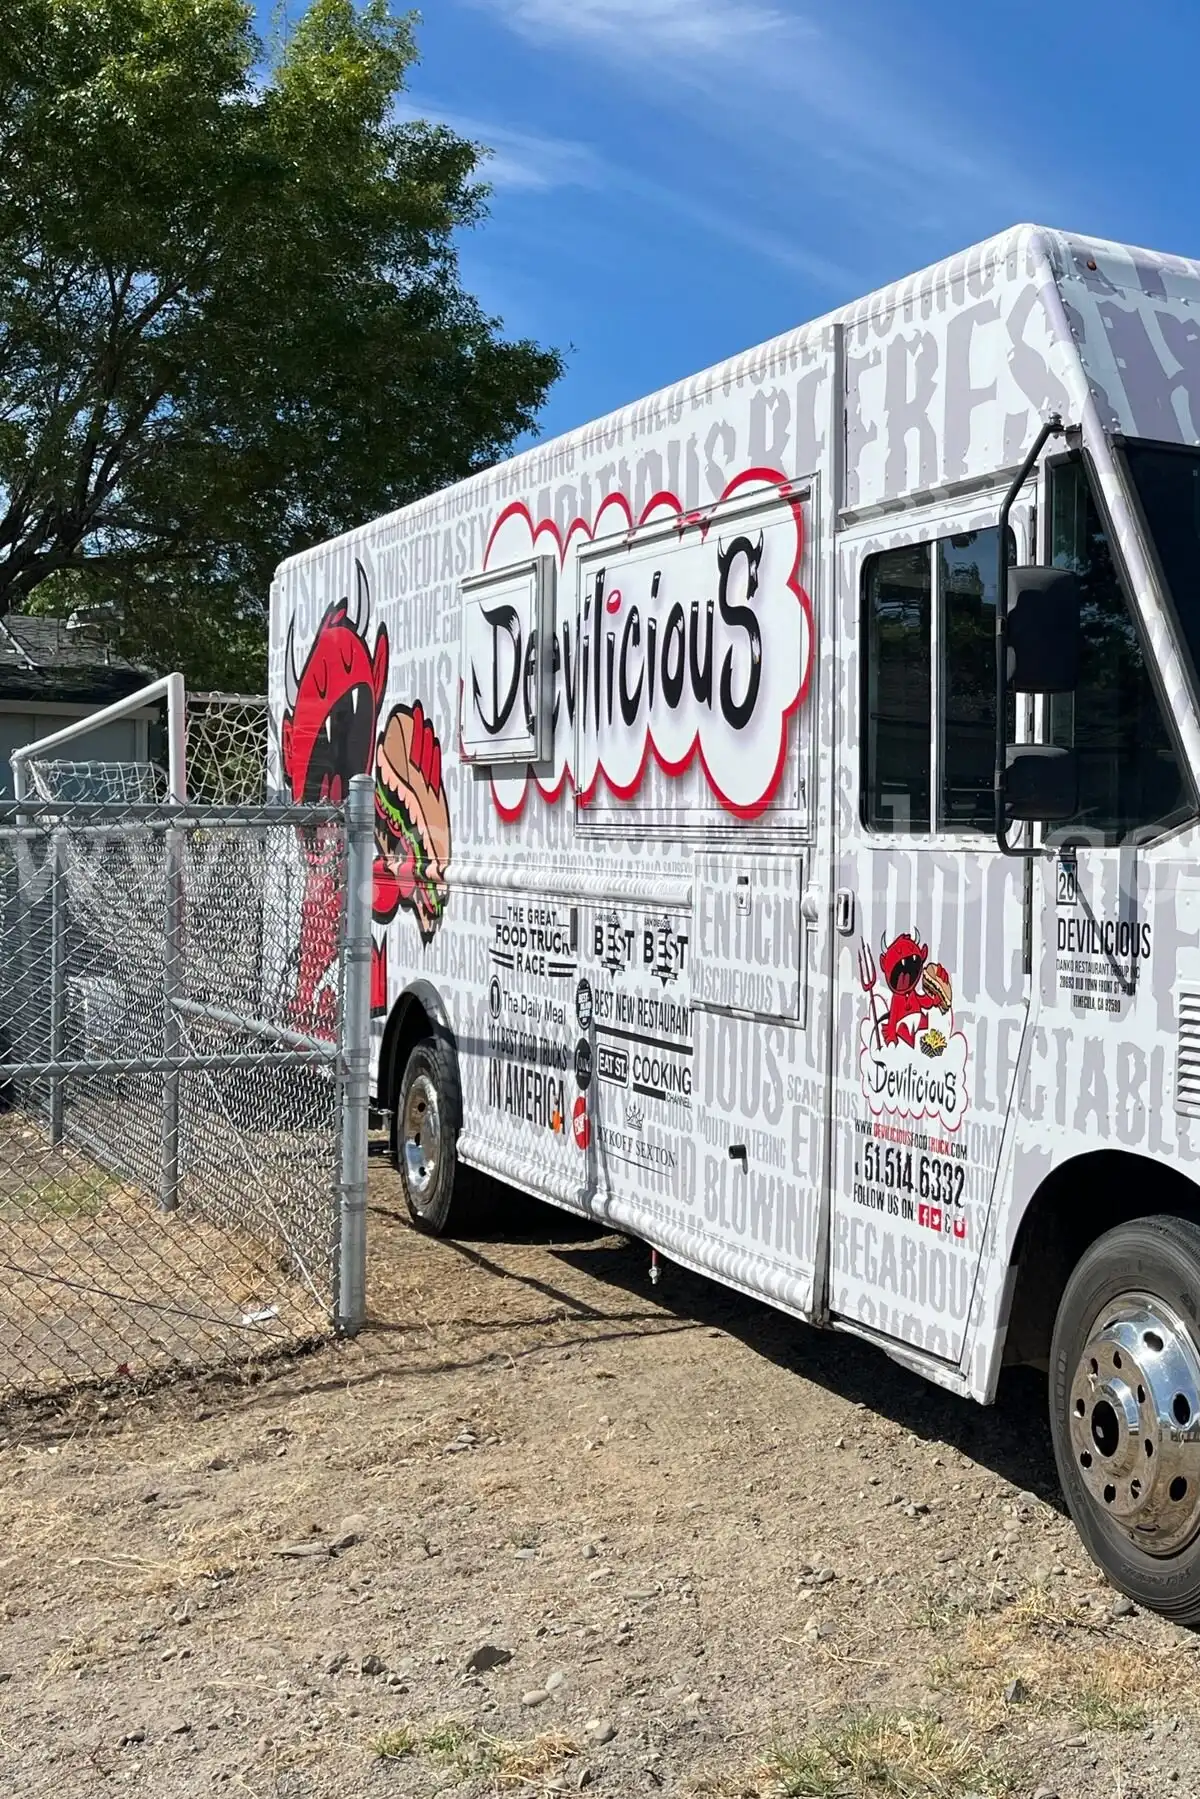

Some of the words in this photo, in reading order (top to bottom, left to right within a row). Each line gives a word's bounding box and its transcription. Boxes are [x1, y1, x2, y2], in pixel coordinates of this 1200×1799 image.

[508, 906, 524, 922] THE
[528, 907, 556, 926] GREAT
[496, 924, 527, 948] FOOD
[594, 924, 635, 962] BEST
[643, 928, 689, 970] BEST
[1057, 917, 1151, 959] DEVILICIOUS
[516, 951, 545, 976] RACE
[1074, 960, 1110, 976] RESTAURANT
[502, 990, 518, 1014] The
[520, 994, 543, 1024] Daily
[544, 1000, 567, 1026] Meal
[594, 988, 614, 1019] BEST
[615, 992, 635, 1025] NEW
[637, 997, 695, 1038] RESTAURANT
[501, 1026, 519, 1055] BEST
[519, 1031, 537, 1063] FOOD
[540, 1037, 568, 1072] TRUCKS
[599, 1050, 614, 1074] EAT
[632, 1054, 692, 1096] COOKING
[488, 1057, 501, 1110] IN
[505, 1062, 566, 1135] AMERICA
[666, 1092, 693, 1109] CHANNEL
[636, 1140, 676, 1168] SEXTON
[853, 1182, 885, 1211] FOLLOW
[887, 1192, 899, 1217] US
